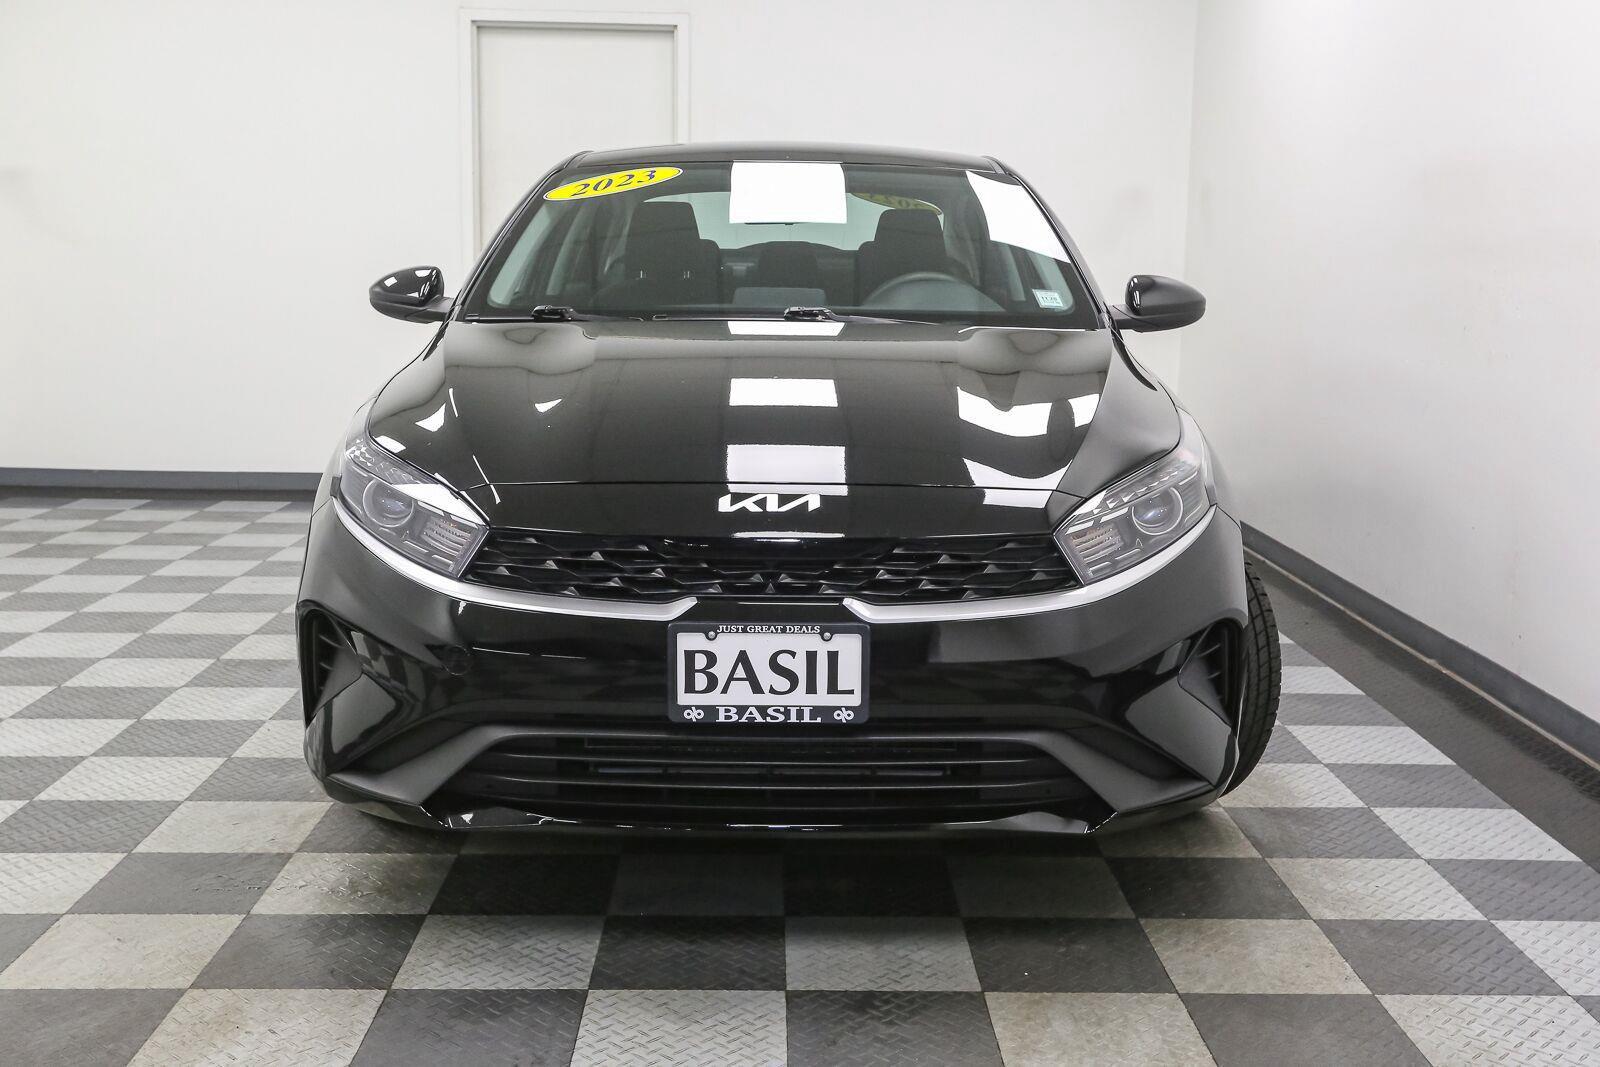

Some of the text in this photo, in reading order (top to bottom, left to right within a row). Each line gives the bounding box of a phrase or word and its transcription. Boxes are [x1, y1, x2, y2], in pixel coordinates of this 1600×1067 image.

[570, 169, 657, 197] 2023
[718, 493, 821, 512] KIA
[716, 625, 821, 634] JUST GREAT DEALS
[683, 649, 855, 696] BASIL
[715, 706, 822, 723] BASIL
